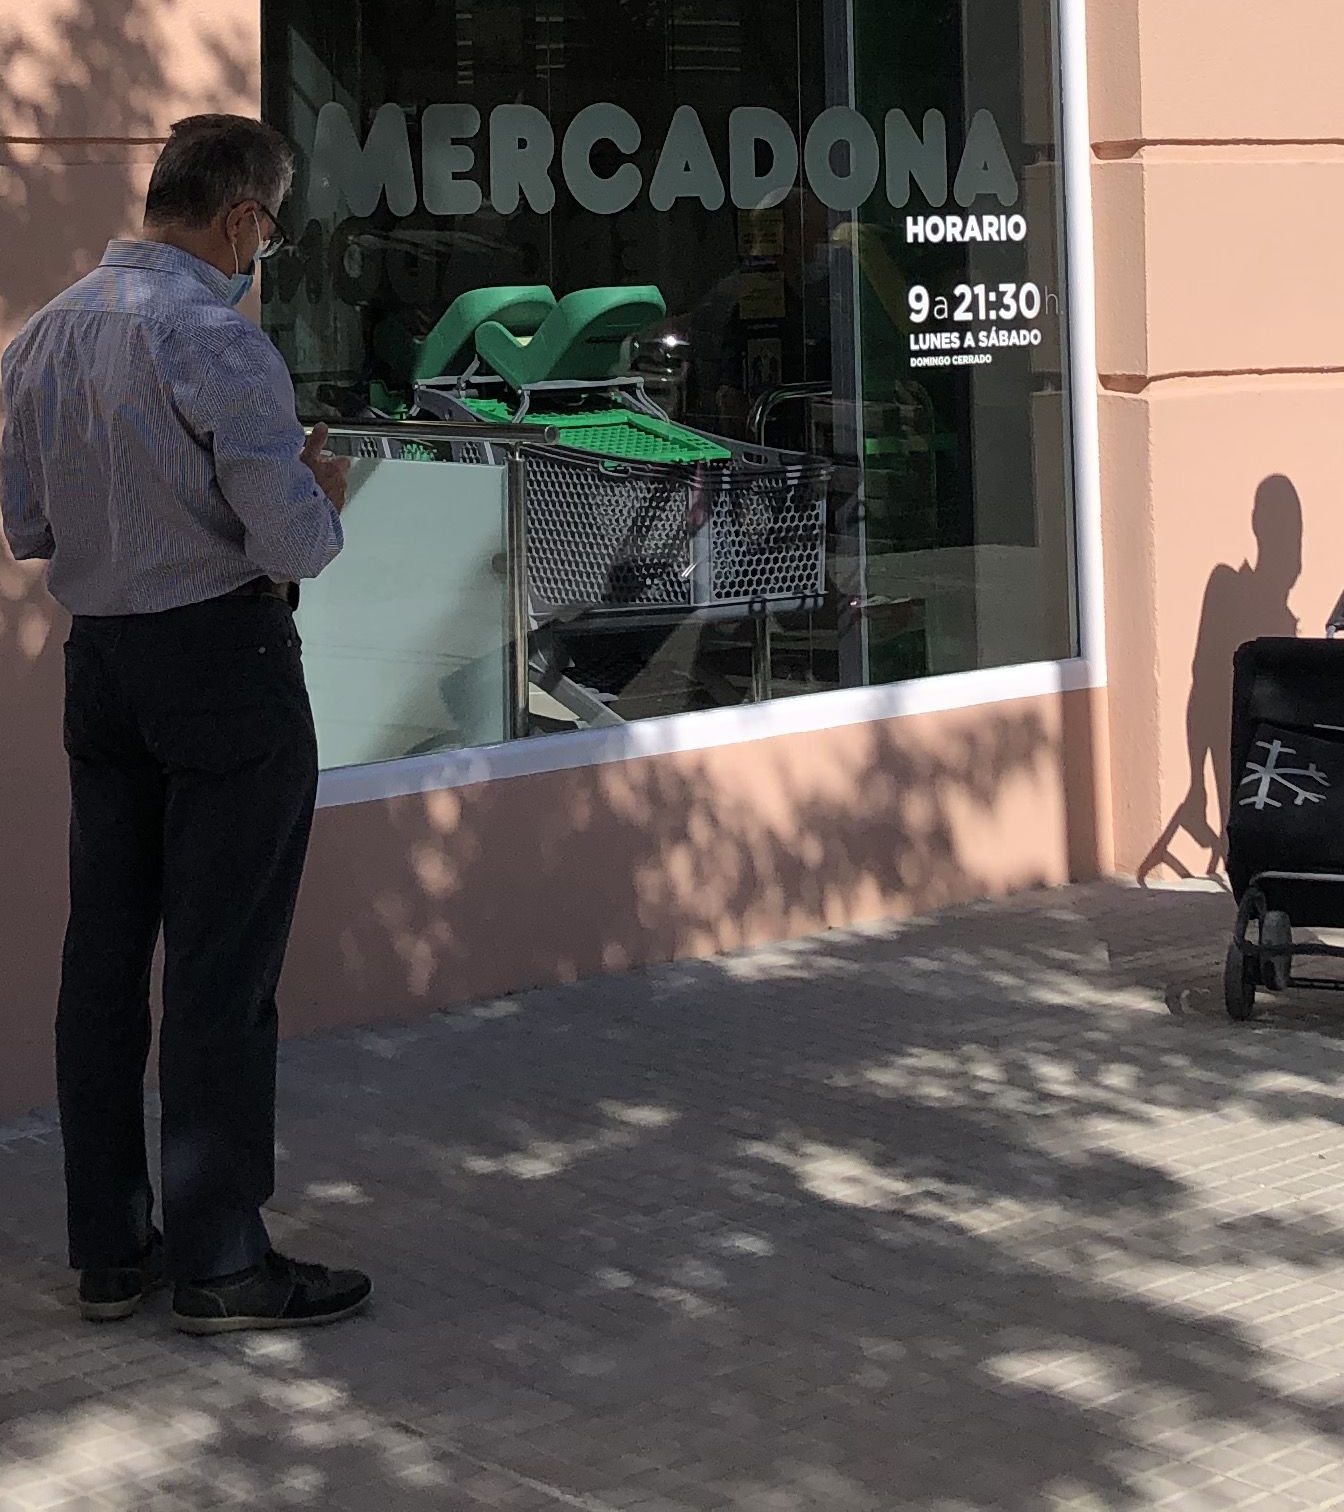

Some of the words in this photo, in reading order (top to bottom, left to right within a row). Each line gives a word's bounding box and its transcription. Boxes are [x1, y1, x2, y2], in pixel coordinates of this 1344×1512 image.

[311, 101, 1019, 218] MERCADONA
[906, 214, 1027, 243] HORARIO
[907, 285, 930, 324] 9
[933, 295, 949, 319] a
[953, 282, 1042, 322] 21:30
[909, 331, 961, 351] LUNES
[963, 330, 976, 348] A
[978, 326, 1042, 347] SÁBADO
[909, 355, 951, 368] DOMINGO
[952, 353, 992, 366] CERRADO
